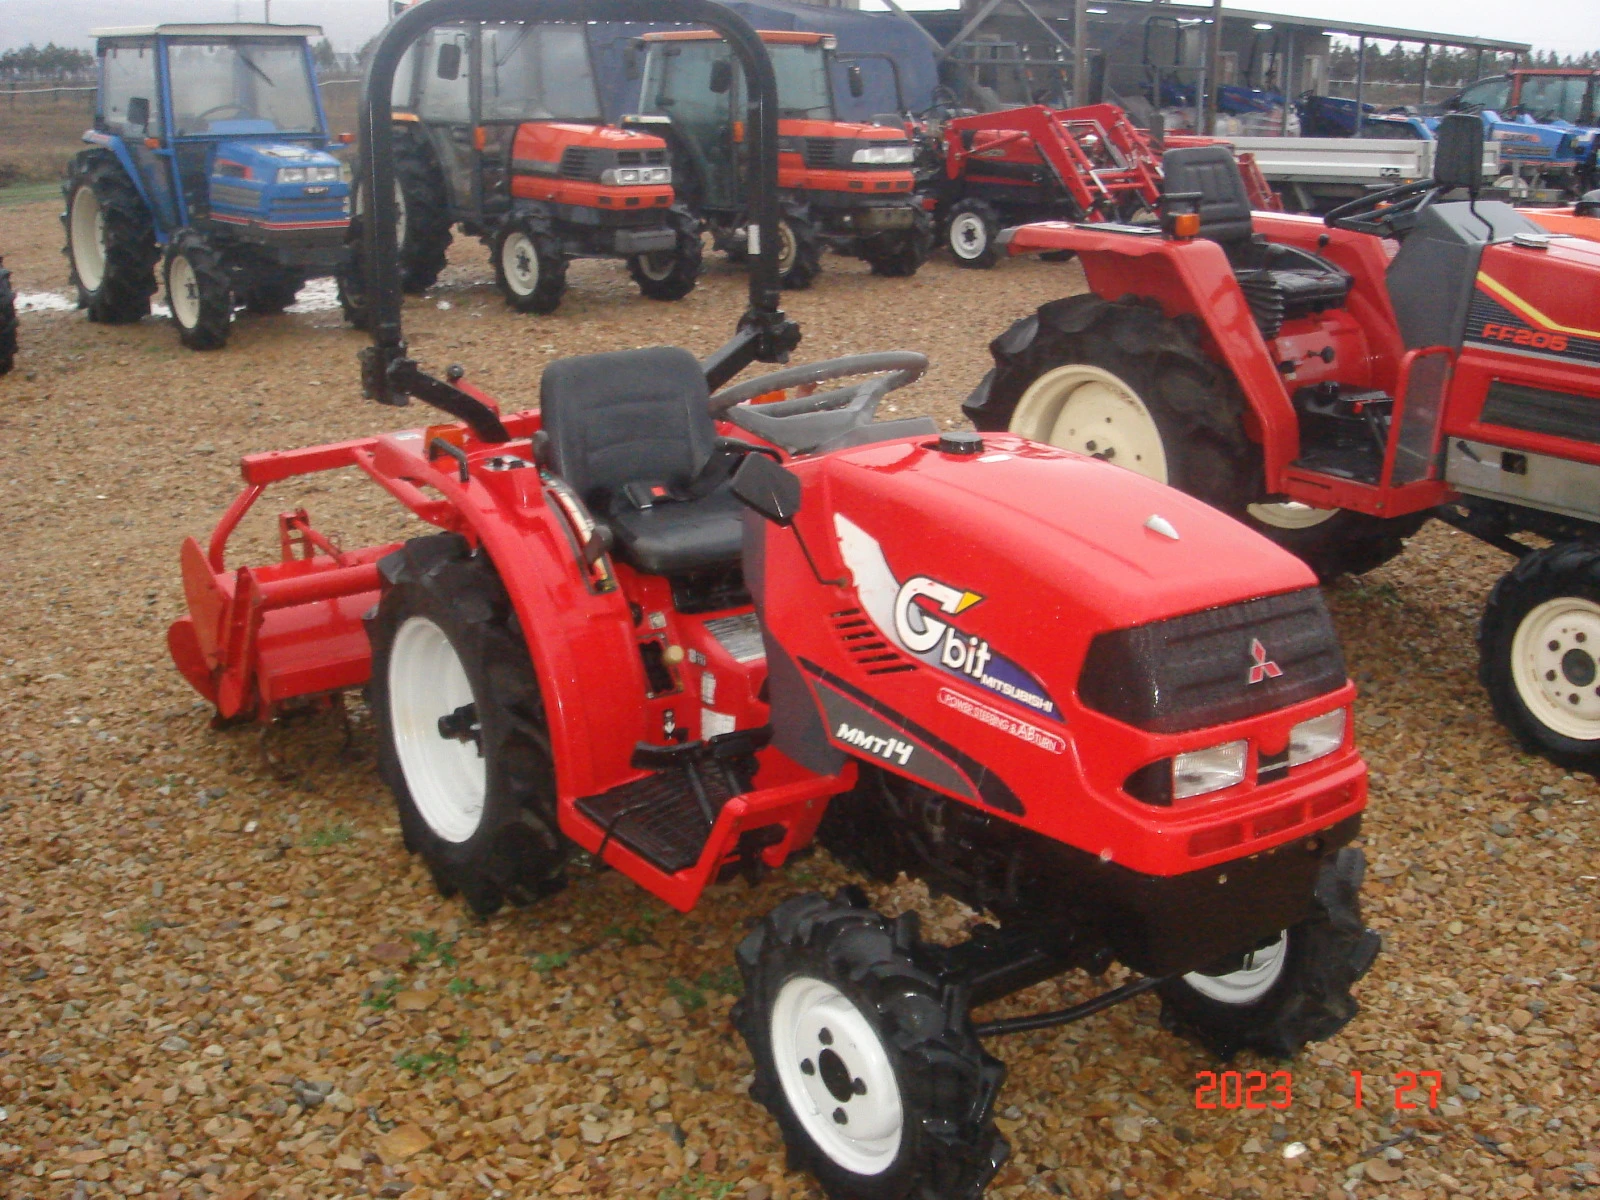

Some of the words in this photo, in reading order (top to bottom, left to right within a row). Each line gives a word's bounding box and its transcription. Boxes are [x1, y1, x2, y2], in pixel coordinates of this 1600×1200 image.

[1482, 323, 1568, 351] FF205
[980, 674, 1053, 712] MITSUBISHI
[836, 722, 914, 765] MMT14
